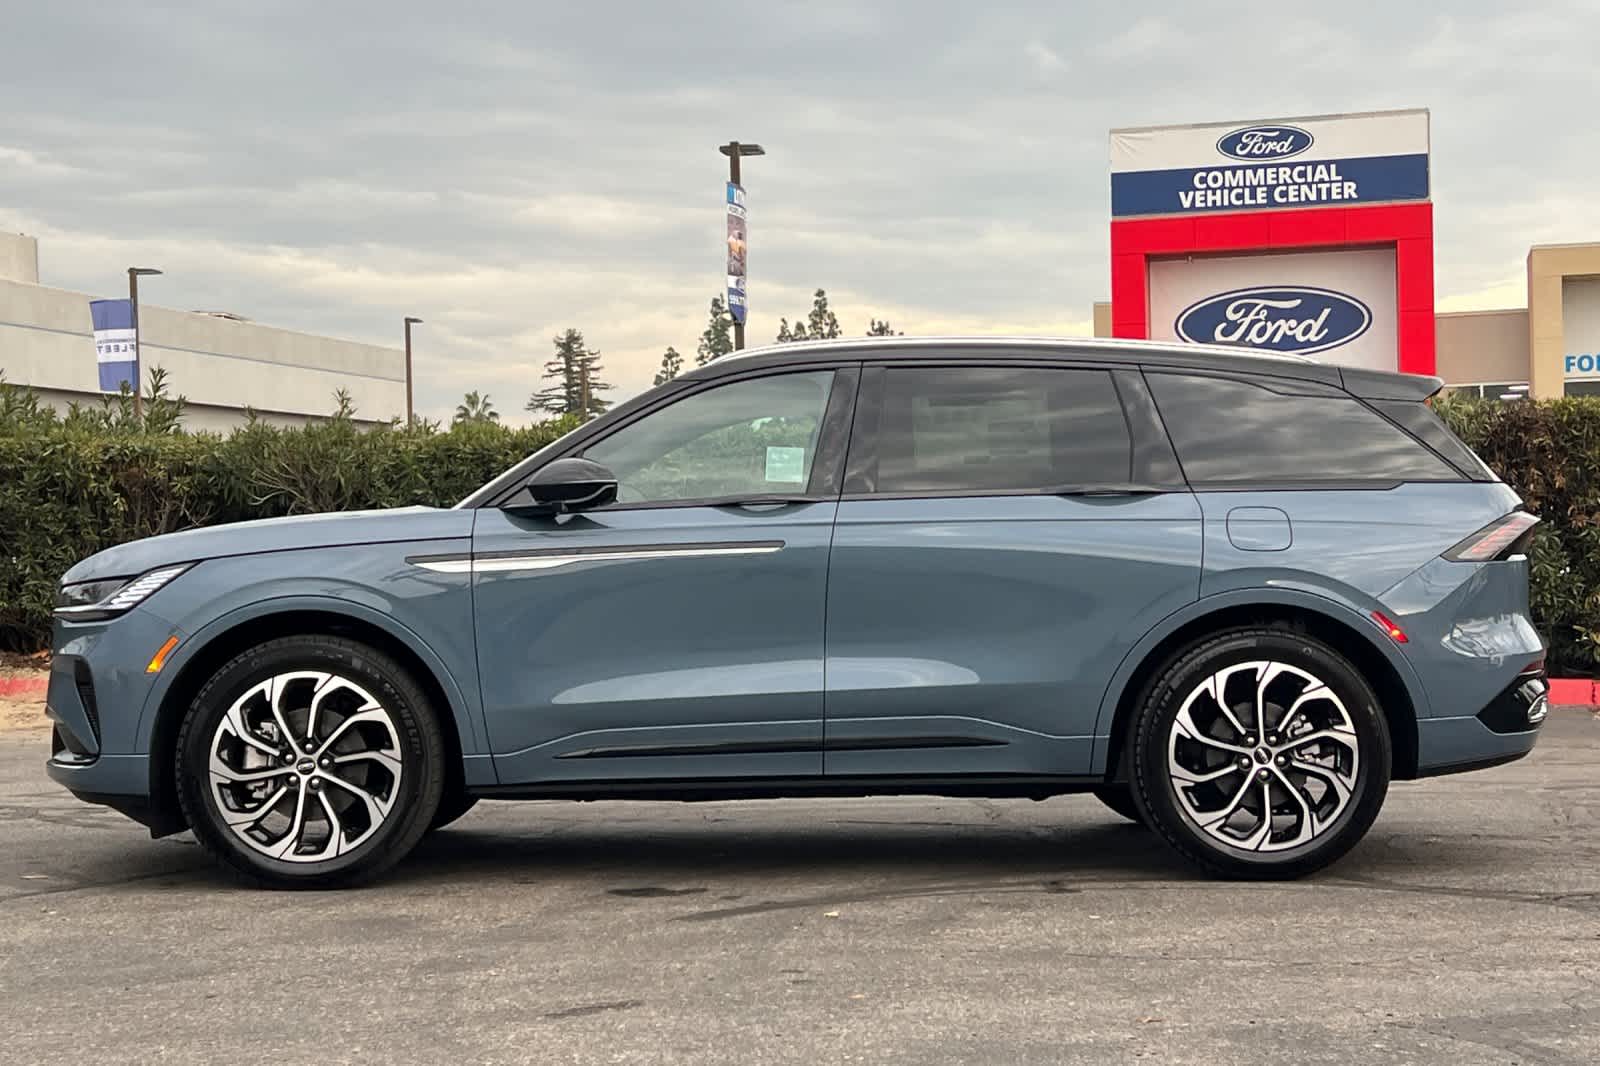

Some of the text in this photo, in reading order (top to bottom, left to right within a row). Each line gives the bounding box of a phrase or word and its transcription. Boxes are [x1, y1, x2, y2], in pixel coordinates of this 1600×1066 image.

[1235, 130, 1294, 155] Ford
[1193, 164, 1342, 189] COMMERCIAL
[1179, 181, 1358, 208] VEHICLE CENTER
[1214, 298, 1332, 344] Ford
